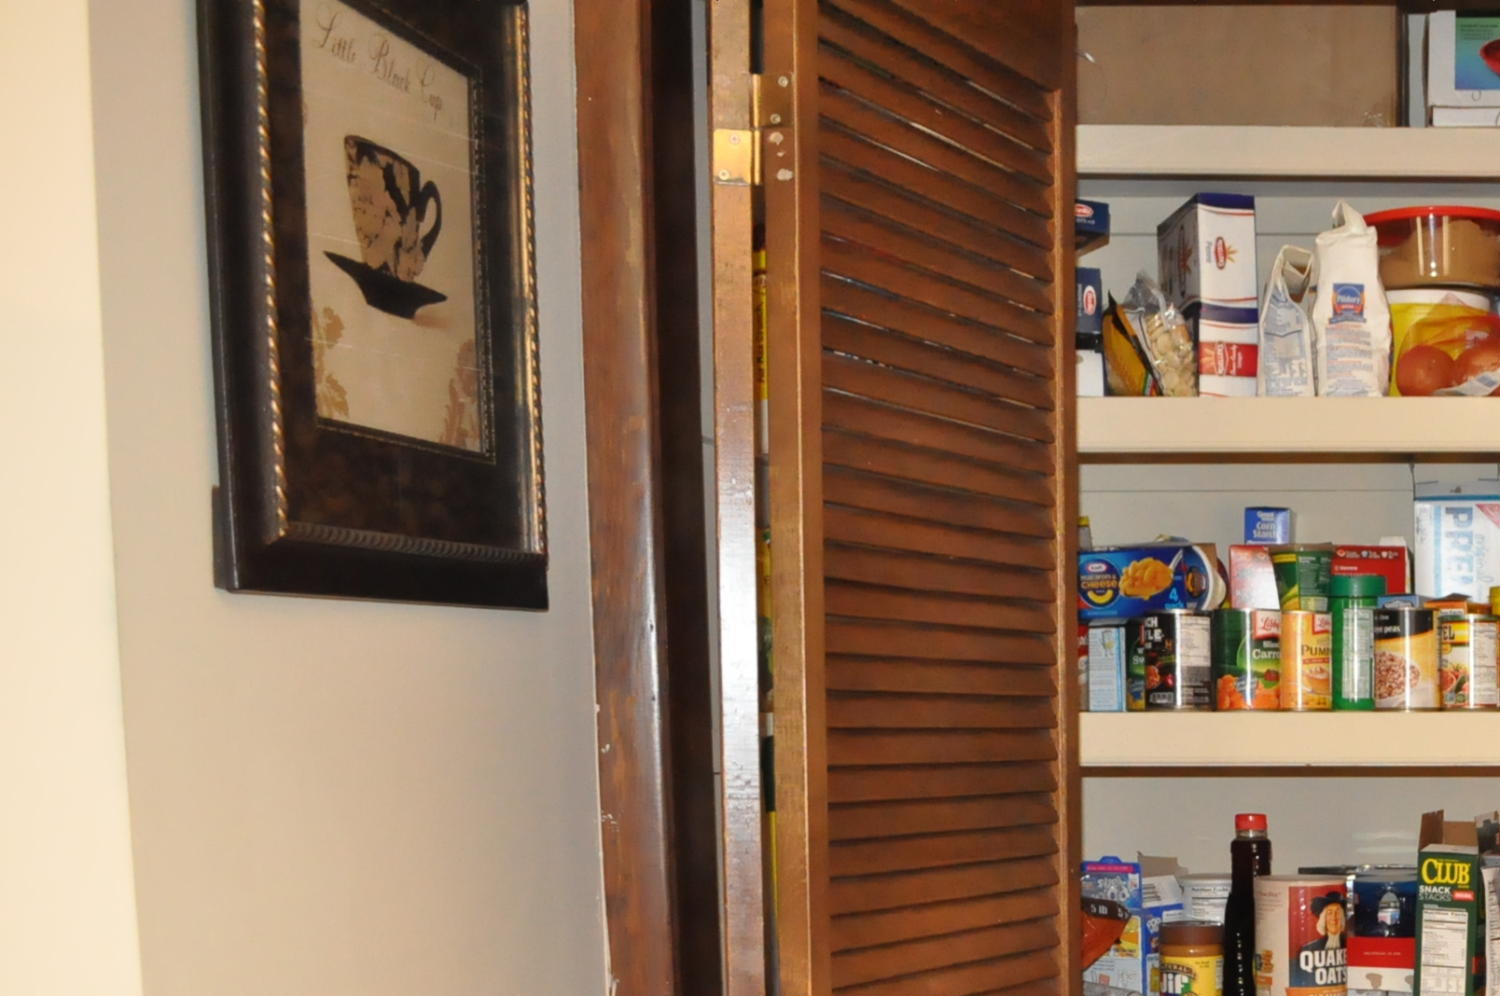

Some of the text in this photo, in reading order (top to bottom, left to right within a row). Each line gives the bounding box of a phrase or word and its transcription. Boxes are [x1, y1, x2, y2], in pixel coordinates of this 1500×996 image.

[312, 4, 356, 64] Little
[1252, 648, 1280, 659] Carro
[1421, 857, 1471, 885] CLUB
[1419, 884, 1451, 895] SNACK
[1299, 948, 1348, 973] QUAKE
